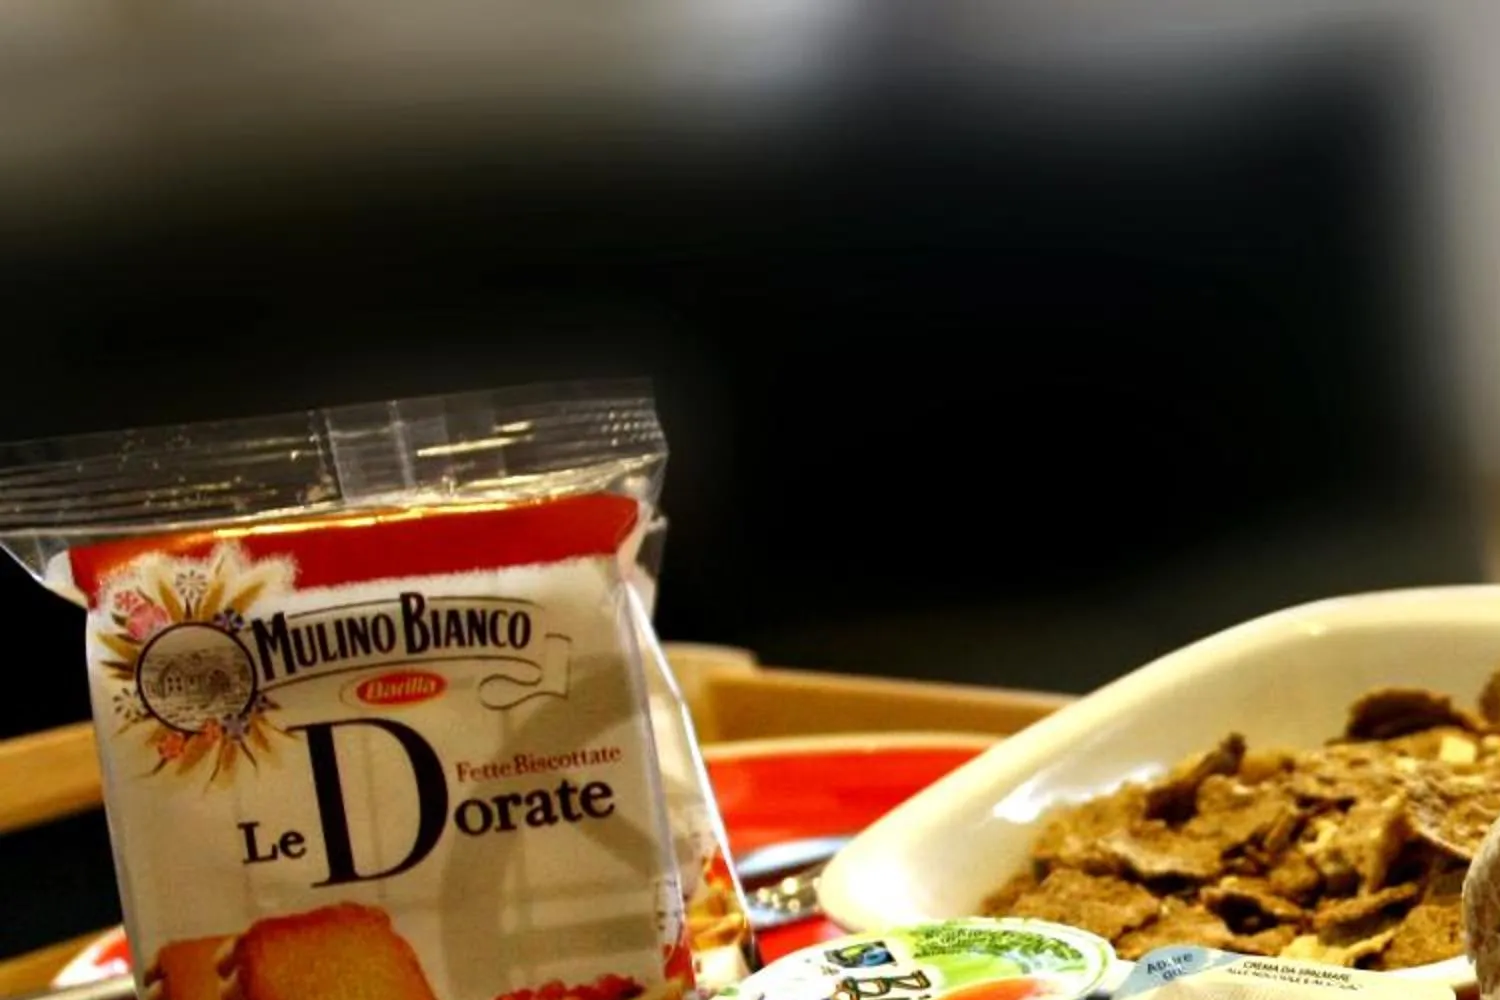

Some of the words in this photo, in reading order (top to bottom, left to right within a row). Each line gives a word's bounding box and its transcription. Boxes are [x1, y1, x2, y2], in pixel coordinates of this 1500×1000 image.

[252, 611, 396, 682] MULINO
[401, 592, 532, 654] BIANCO
[366, 676, 437, 699] Barilla
[455, 760, 512, 783] Fette
[513, 746, 622, 775] Biscottate
[237, 821, 307, 865] Le
